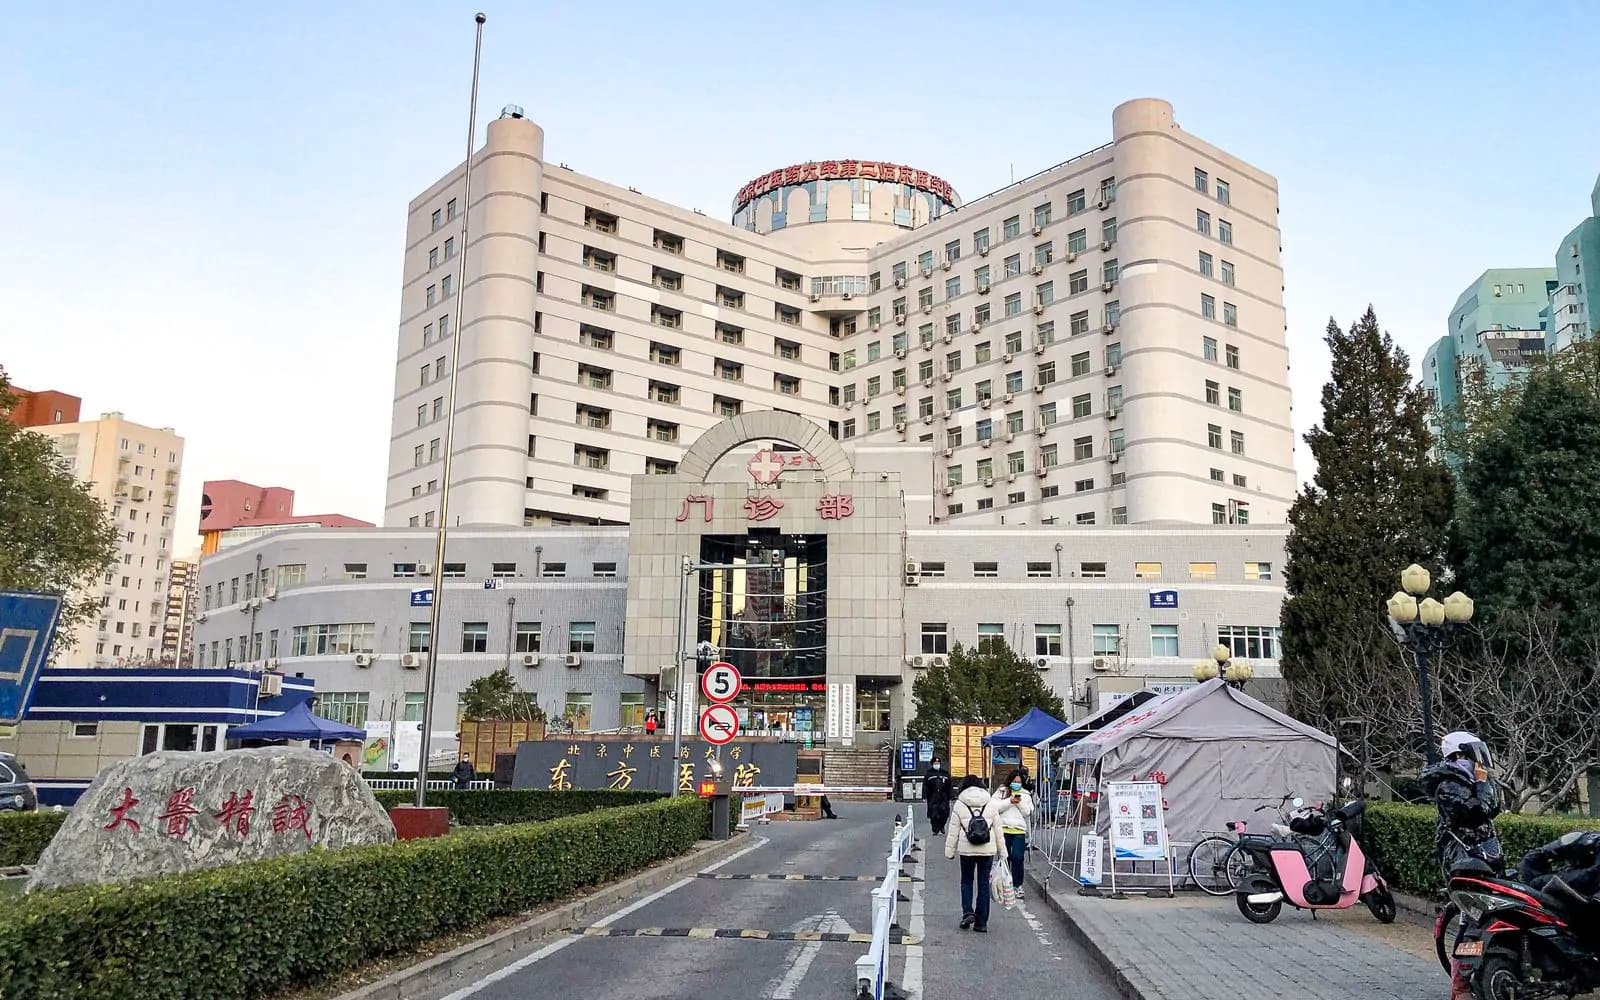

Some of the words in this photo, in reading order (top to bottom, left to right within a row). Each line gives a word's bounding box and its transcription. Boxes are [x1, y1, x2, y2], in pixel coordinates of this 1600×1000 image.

[737, 159, 953, 206] 北京中医药大学第二临床医学院
[676, 494, 855, 522] 门诊部
[714, 672, 729, 694] 5
[567, 743, 743, 760] 北京中医药大学
[548, 758, 762, 793] 东方医院
[104, 786, 313, 840] 大醫精誠
[1085, 839, 1097, 877] 预约挂号
